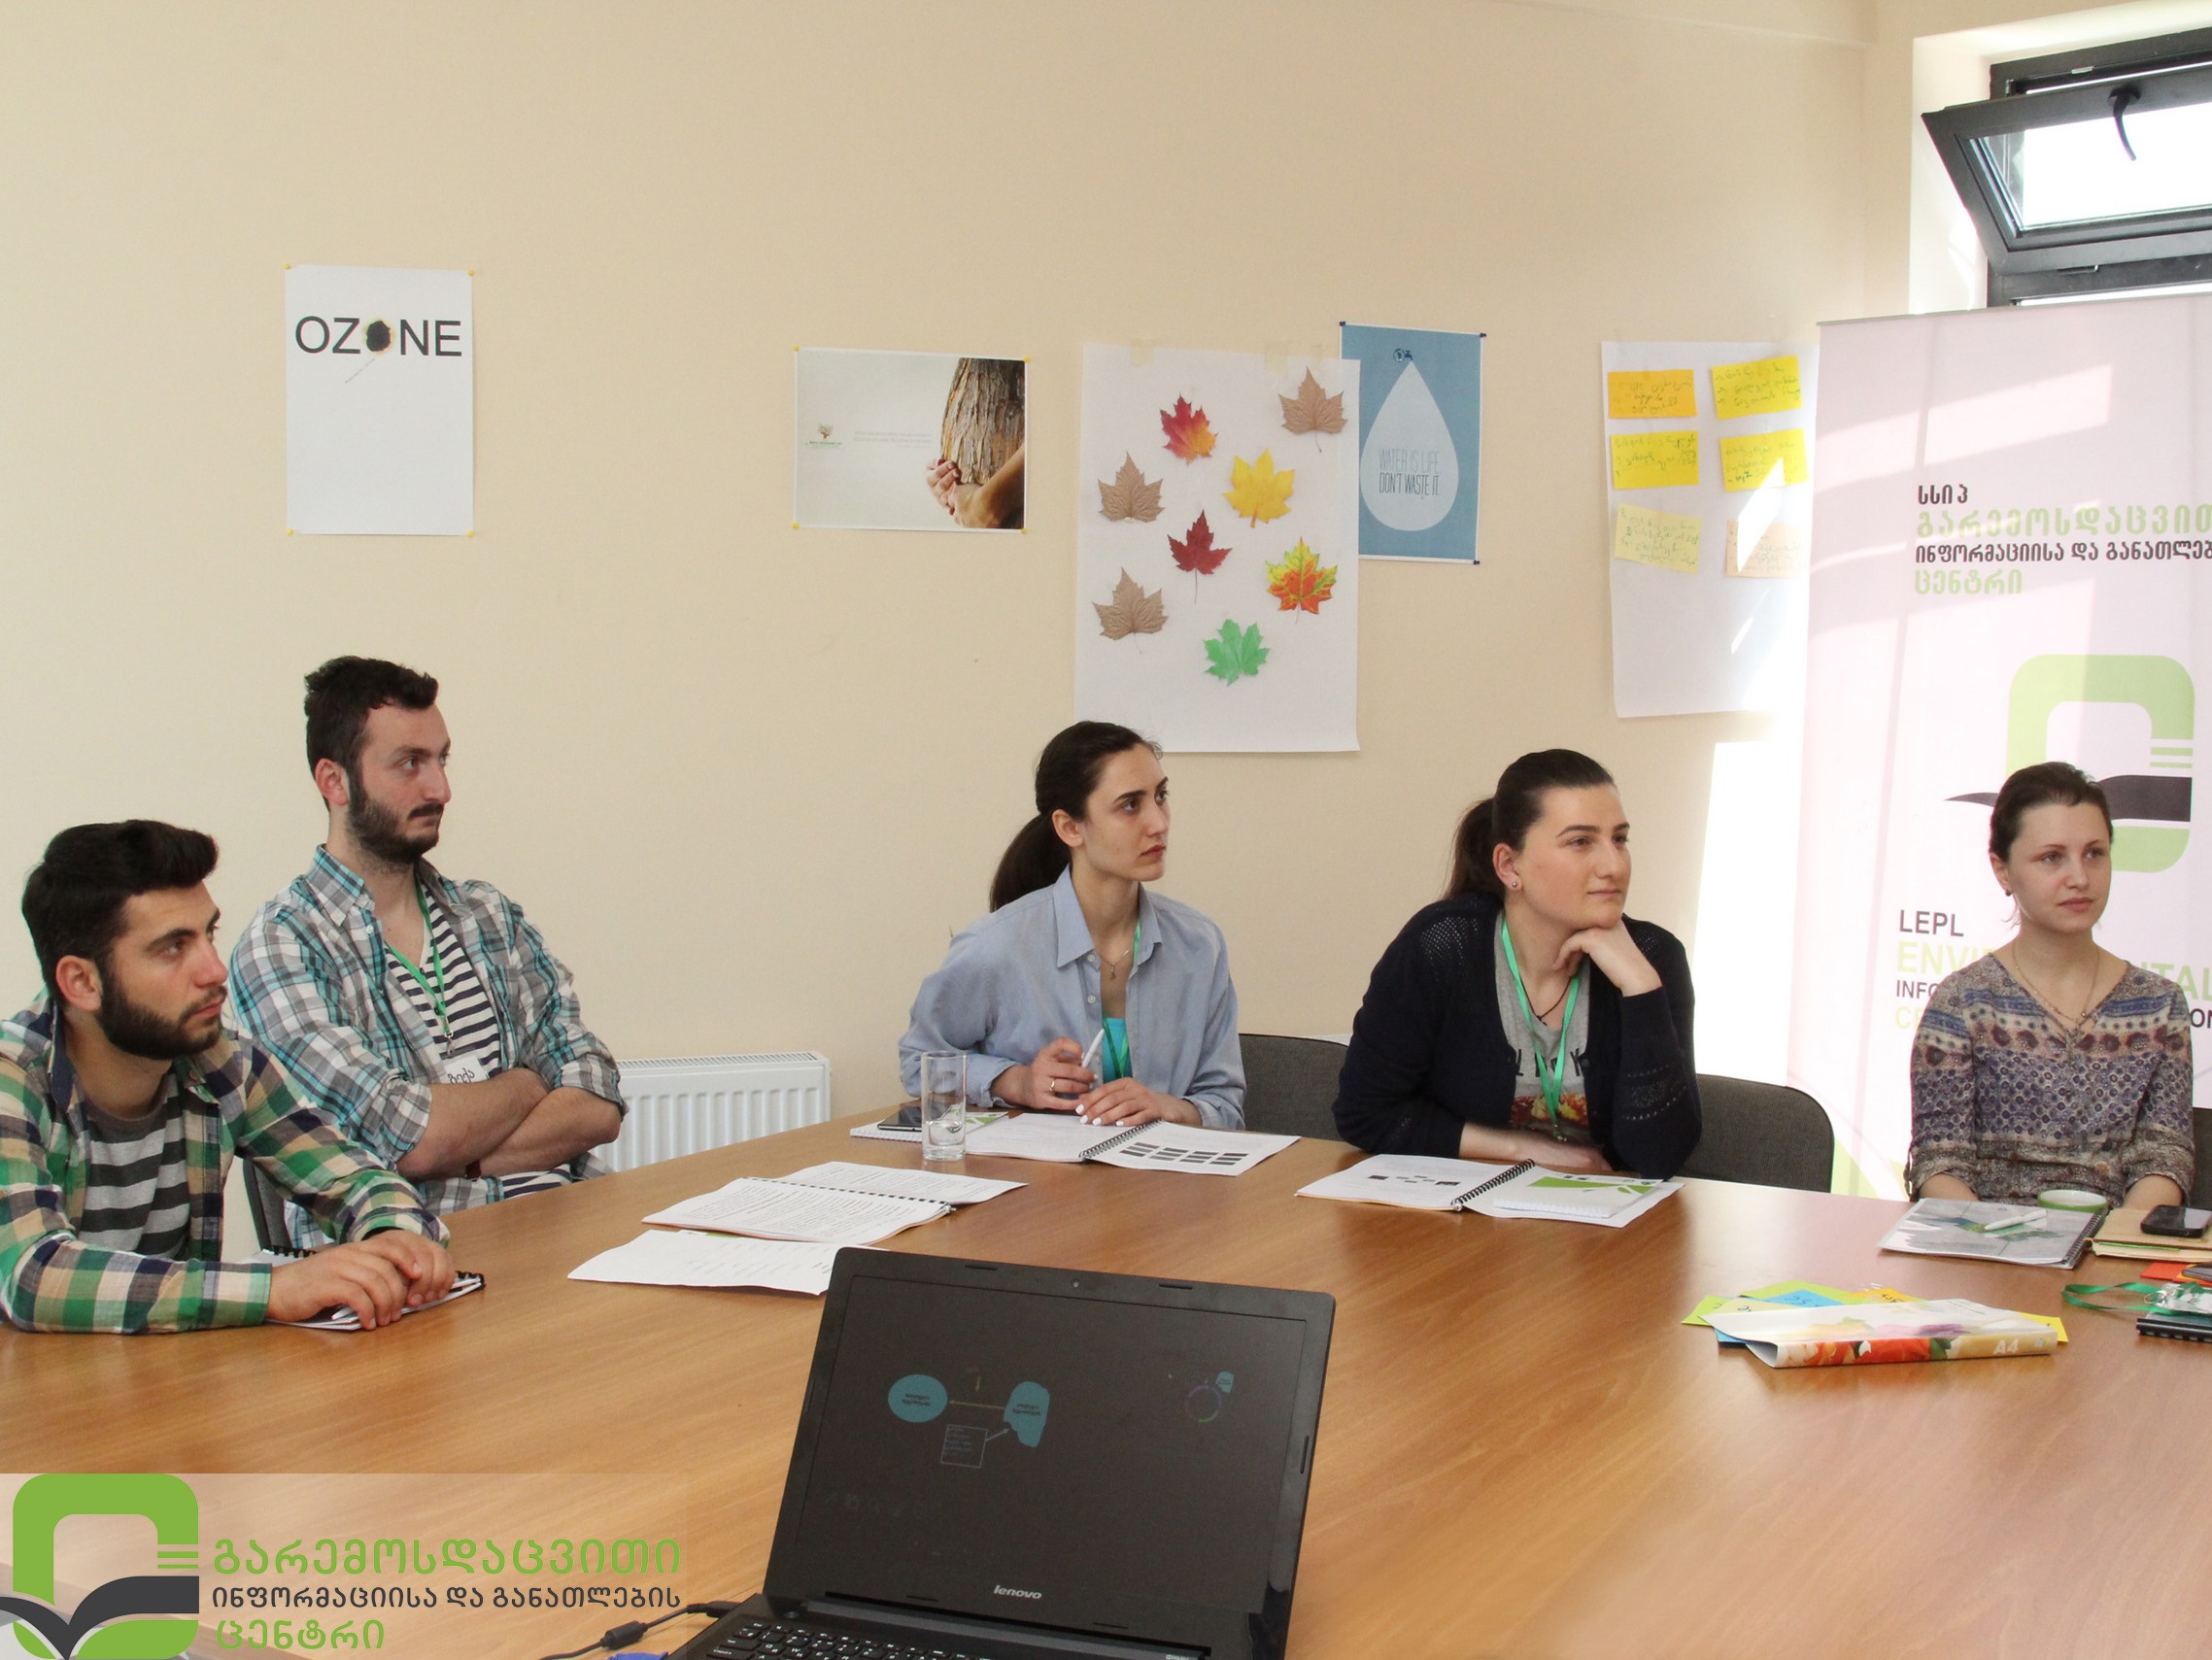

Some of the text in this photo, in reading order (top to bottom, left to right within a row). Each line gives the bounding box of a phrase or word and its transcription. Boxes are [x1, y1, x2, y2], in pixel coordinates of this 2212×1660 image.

[1379, 449, 1440, 474] WATER IS LIFE
[1379, 472, 1402, 493] DON'T
[1405, 474, 1429, 496] WASTE
[1918, 484, 1968, 504] სსიპ
[1916, 543, 2064, 563] ინფორმაციისა
[2071, 542, 2098, 560] და
[1914, 568, 2023, 595] ცენტრი
[1899, 909, 1964, 937] LEPL
[1993, 1338, 2019, 1355] A4
[993, 1584, 1042, 1599] lenovo
